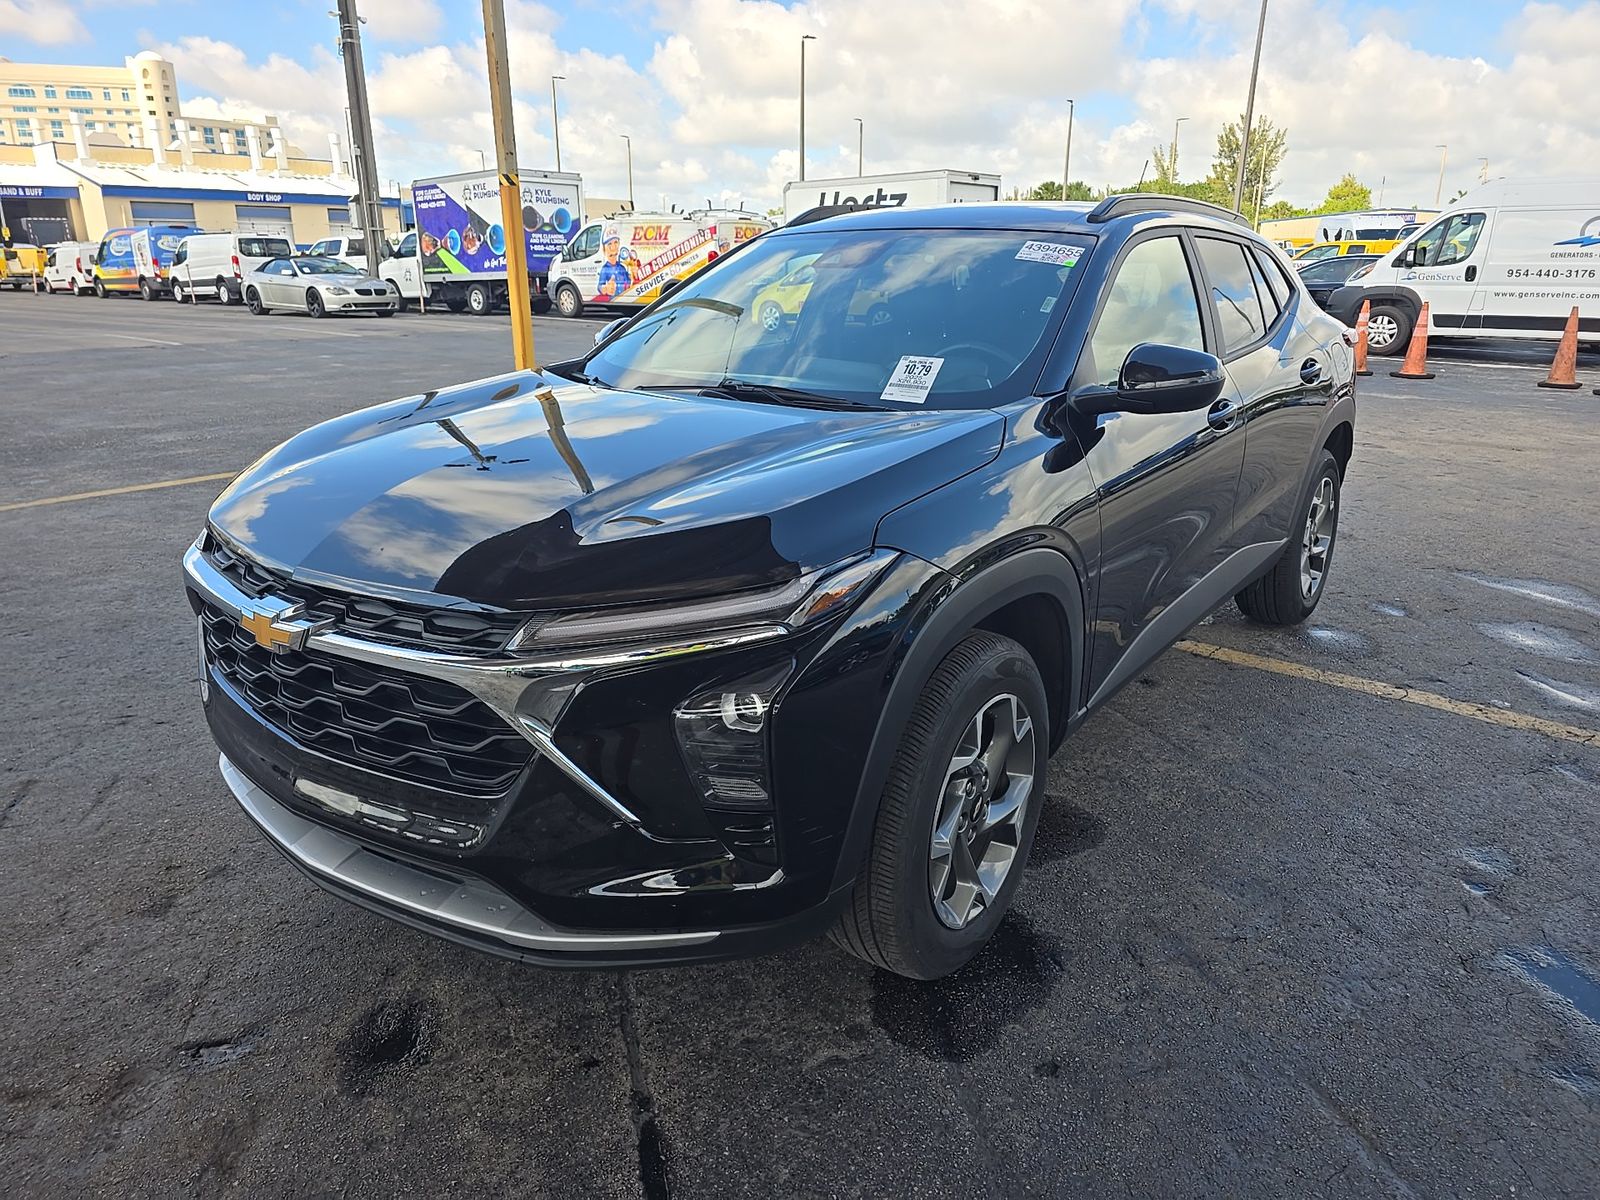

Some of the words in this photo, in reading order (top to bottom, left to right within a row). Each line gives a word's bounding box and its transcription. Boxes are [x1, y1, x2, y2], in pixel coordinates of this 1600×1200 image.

[18, 187, 24, 196] &
[24, 187, 43, 196] BUFF
[473, 183, 486, 191] KYLE
[474, 189, 500, 199] PLUMBIN
[535, 188, 552, 197] KYLE
[247, 193, 264, 201] BODY
[265, 194, 282, 202] SHOP
[536, 196, 570, 205] PLUMBING
[632, 225, 671, 241] ECM
[637, 262, 651, 280] AIR
[653, 229, 711, 272] CONDITIONING
[1024, 243, 1083, 258] 4394655
[1418, 272, 1462, 281] GenServe
[1507, 268, 1596, 279] 954-440-3176
[635, 273, 666, 296] SERVICE
[1494, 290, 1600, 299] www.genserveinc.com
[903, 363, 932, 376] 10:79
